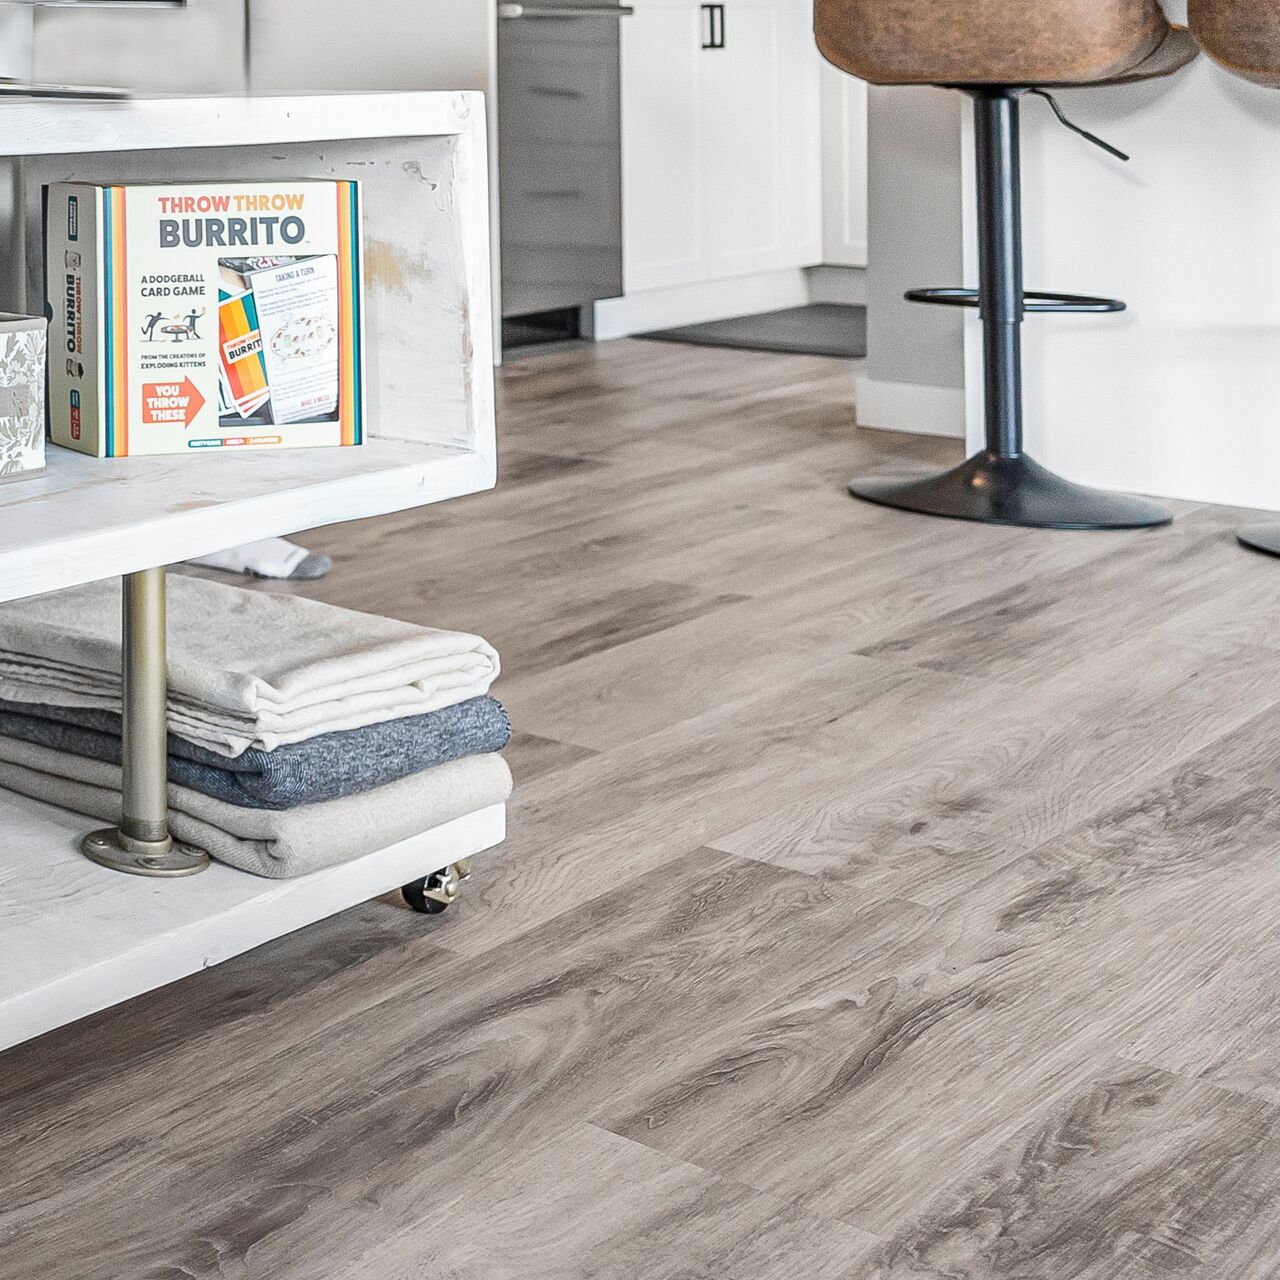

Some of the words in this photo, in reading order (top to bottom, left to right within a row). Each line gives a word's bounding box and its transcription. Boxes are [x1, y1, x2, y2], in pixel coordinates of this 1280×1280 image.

[158, 195, 231, 214] THROW
[233, 194, 305, 212] THROW
[159, 215, 306, 249] BURRITO
[141, 275, 148, 284] A
[149, 274, 205, 284] DODGEBALL
[141, 287, 171, 297] CARD
[172, 286, 206, 296] GAME
[66, 274, 76, 353] BURRITO
[228, 338, 262, 360] BURRIT
[141, 362, 178, 370] EXPLODING
[179, 361, 206, 369] KITTENS
[155, 385, 180, 396] YOU
[146, 396, 190, 409] THROW
[150, 409, 187, 421] THESE
